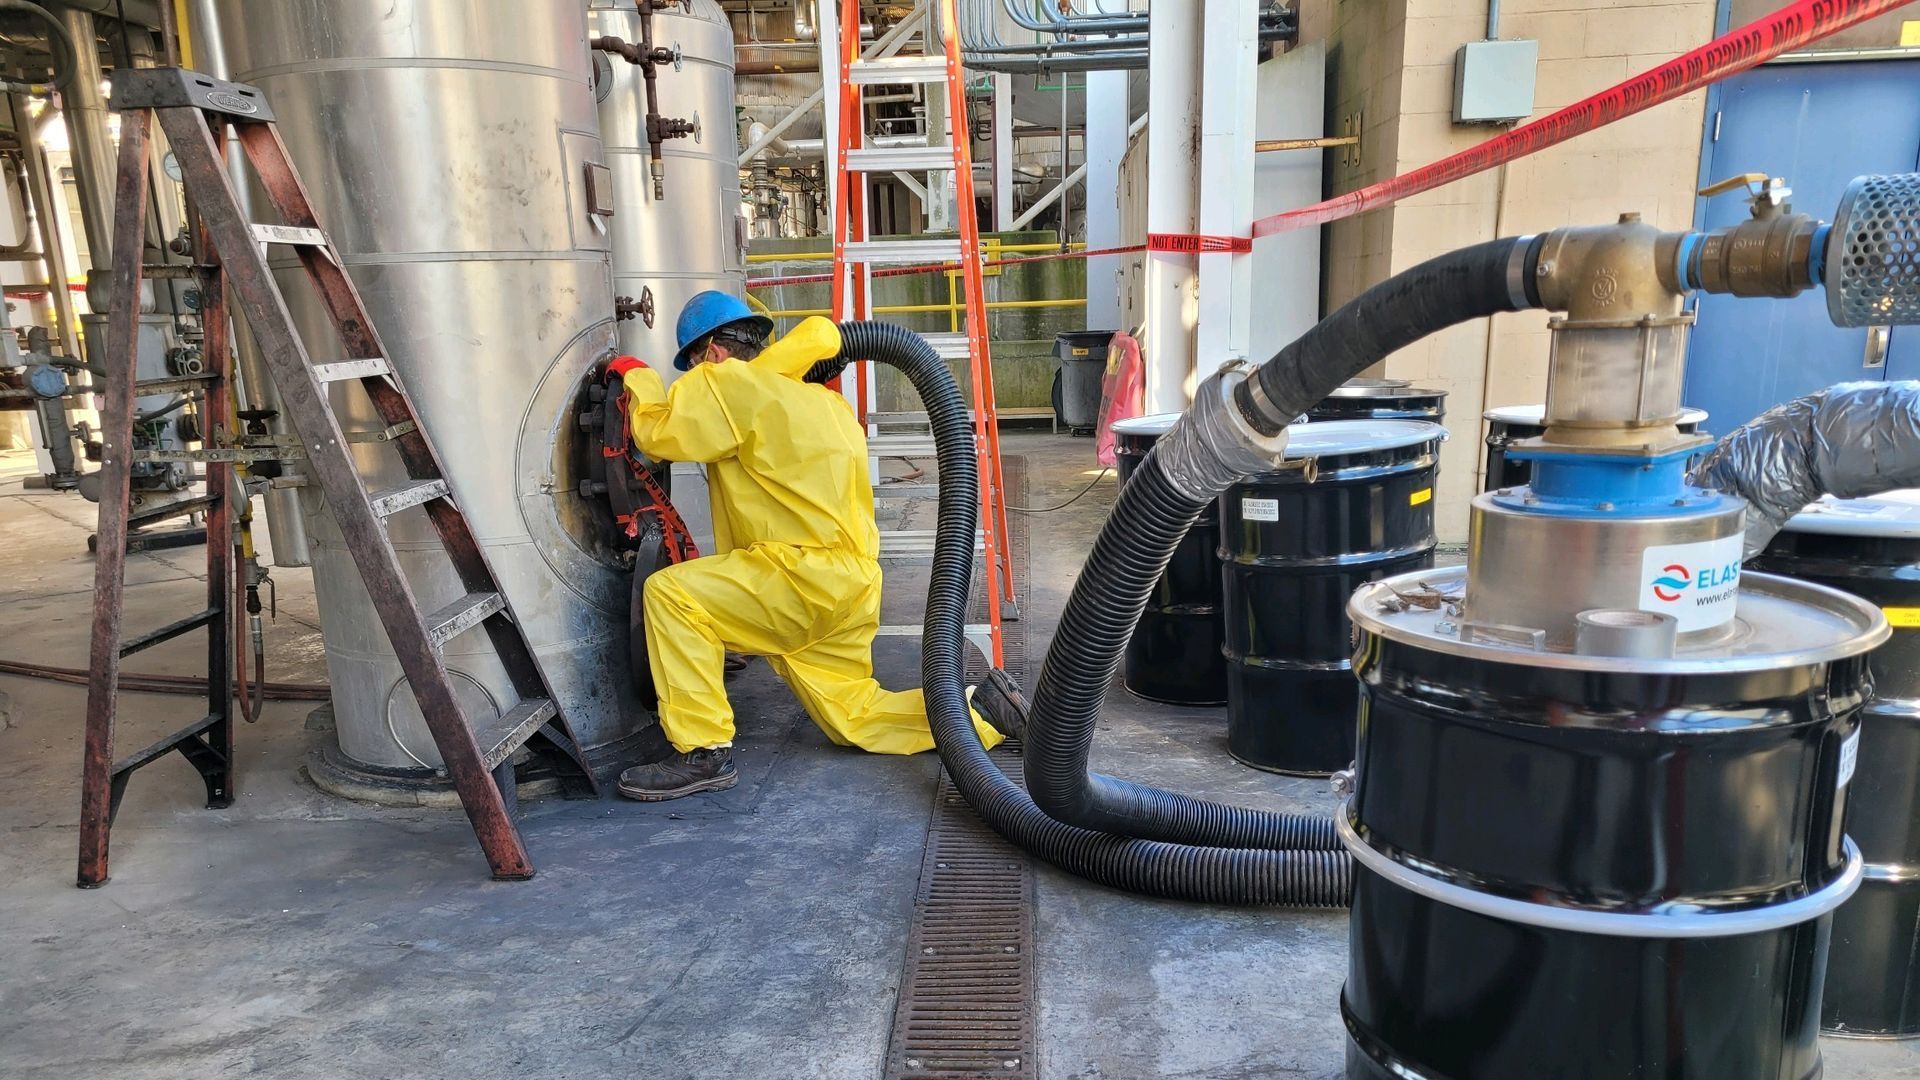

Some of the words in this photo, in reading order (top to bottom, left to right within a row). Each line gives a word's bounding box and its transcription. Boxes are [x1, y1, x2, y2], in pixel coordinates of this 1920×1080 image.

[1152, 236, 1169, 249] NOT
[1171, 238, 1199, 252] ENTER
[1697, 561, 1740, 589] ELAS
